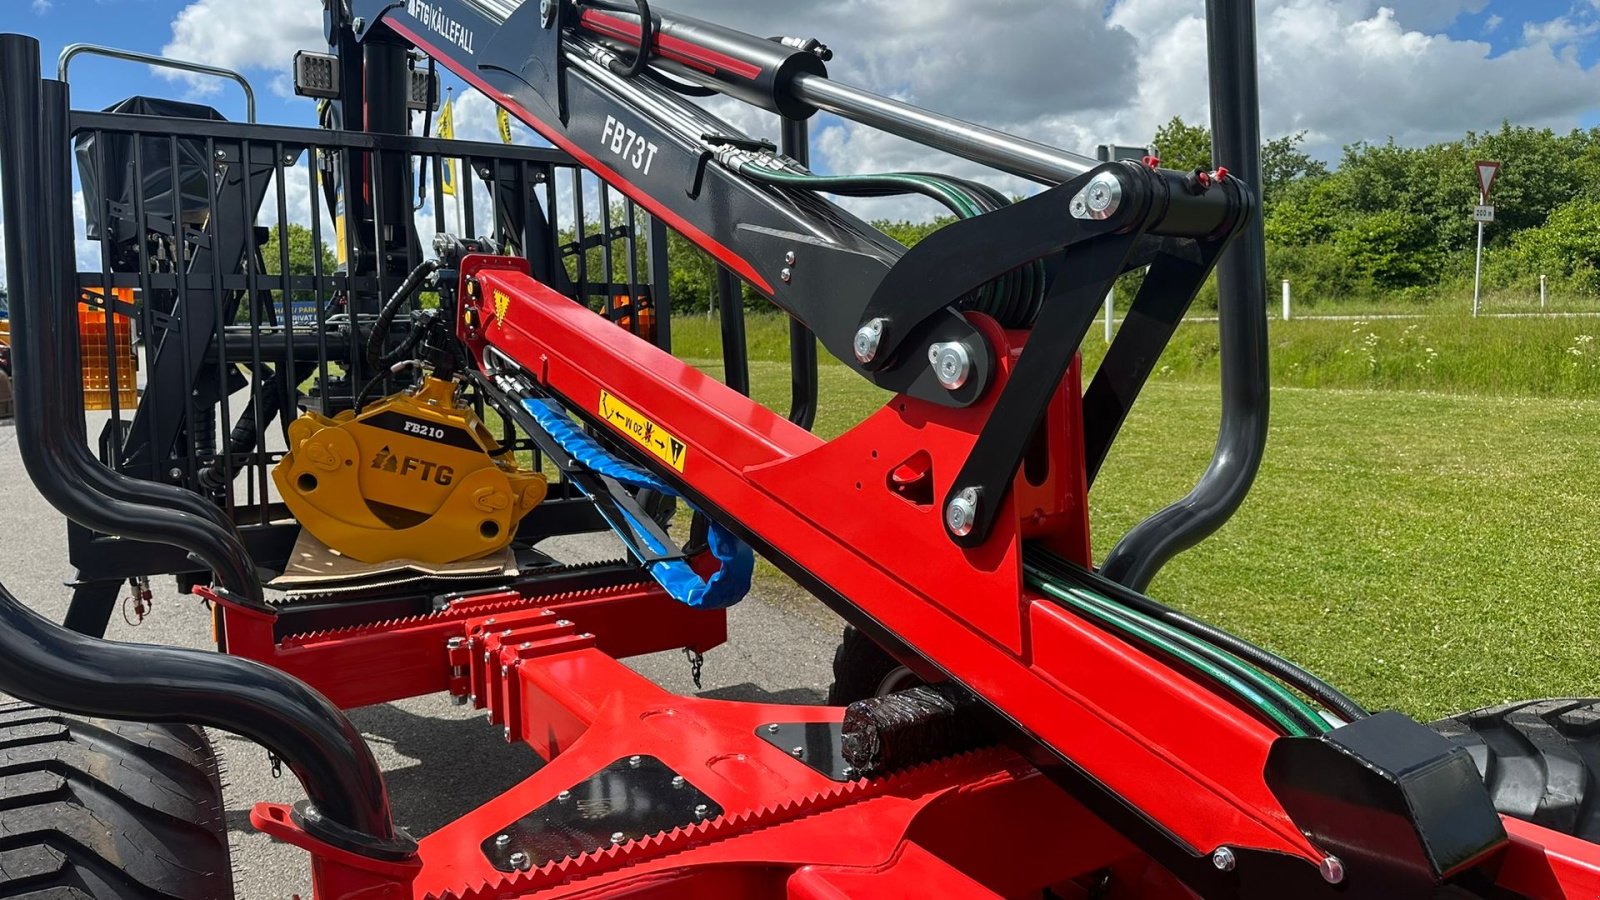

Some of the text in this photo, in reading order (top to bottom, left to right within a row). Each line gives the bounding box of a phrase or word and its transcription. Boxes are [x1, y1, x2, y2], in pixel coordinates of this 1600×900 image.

[600, 114, 659, 176] FB73T
[1476, 209, 1487, 217] 200
[403, 420, 445, 439] FB210
[625, 416, 643, 436] 20 M
[399, 455, 455, 486] FTG
